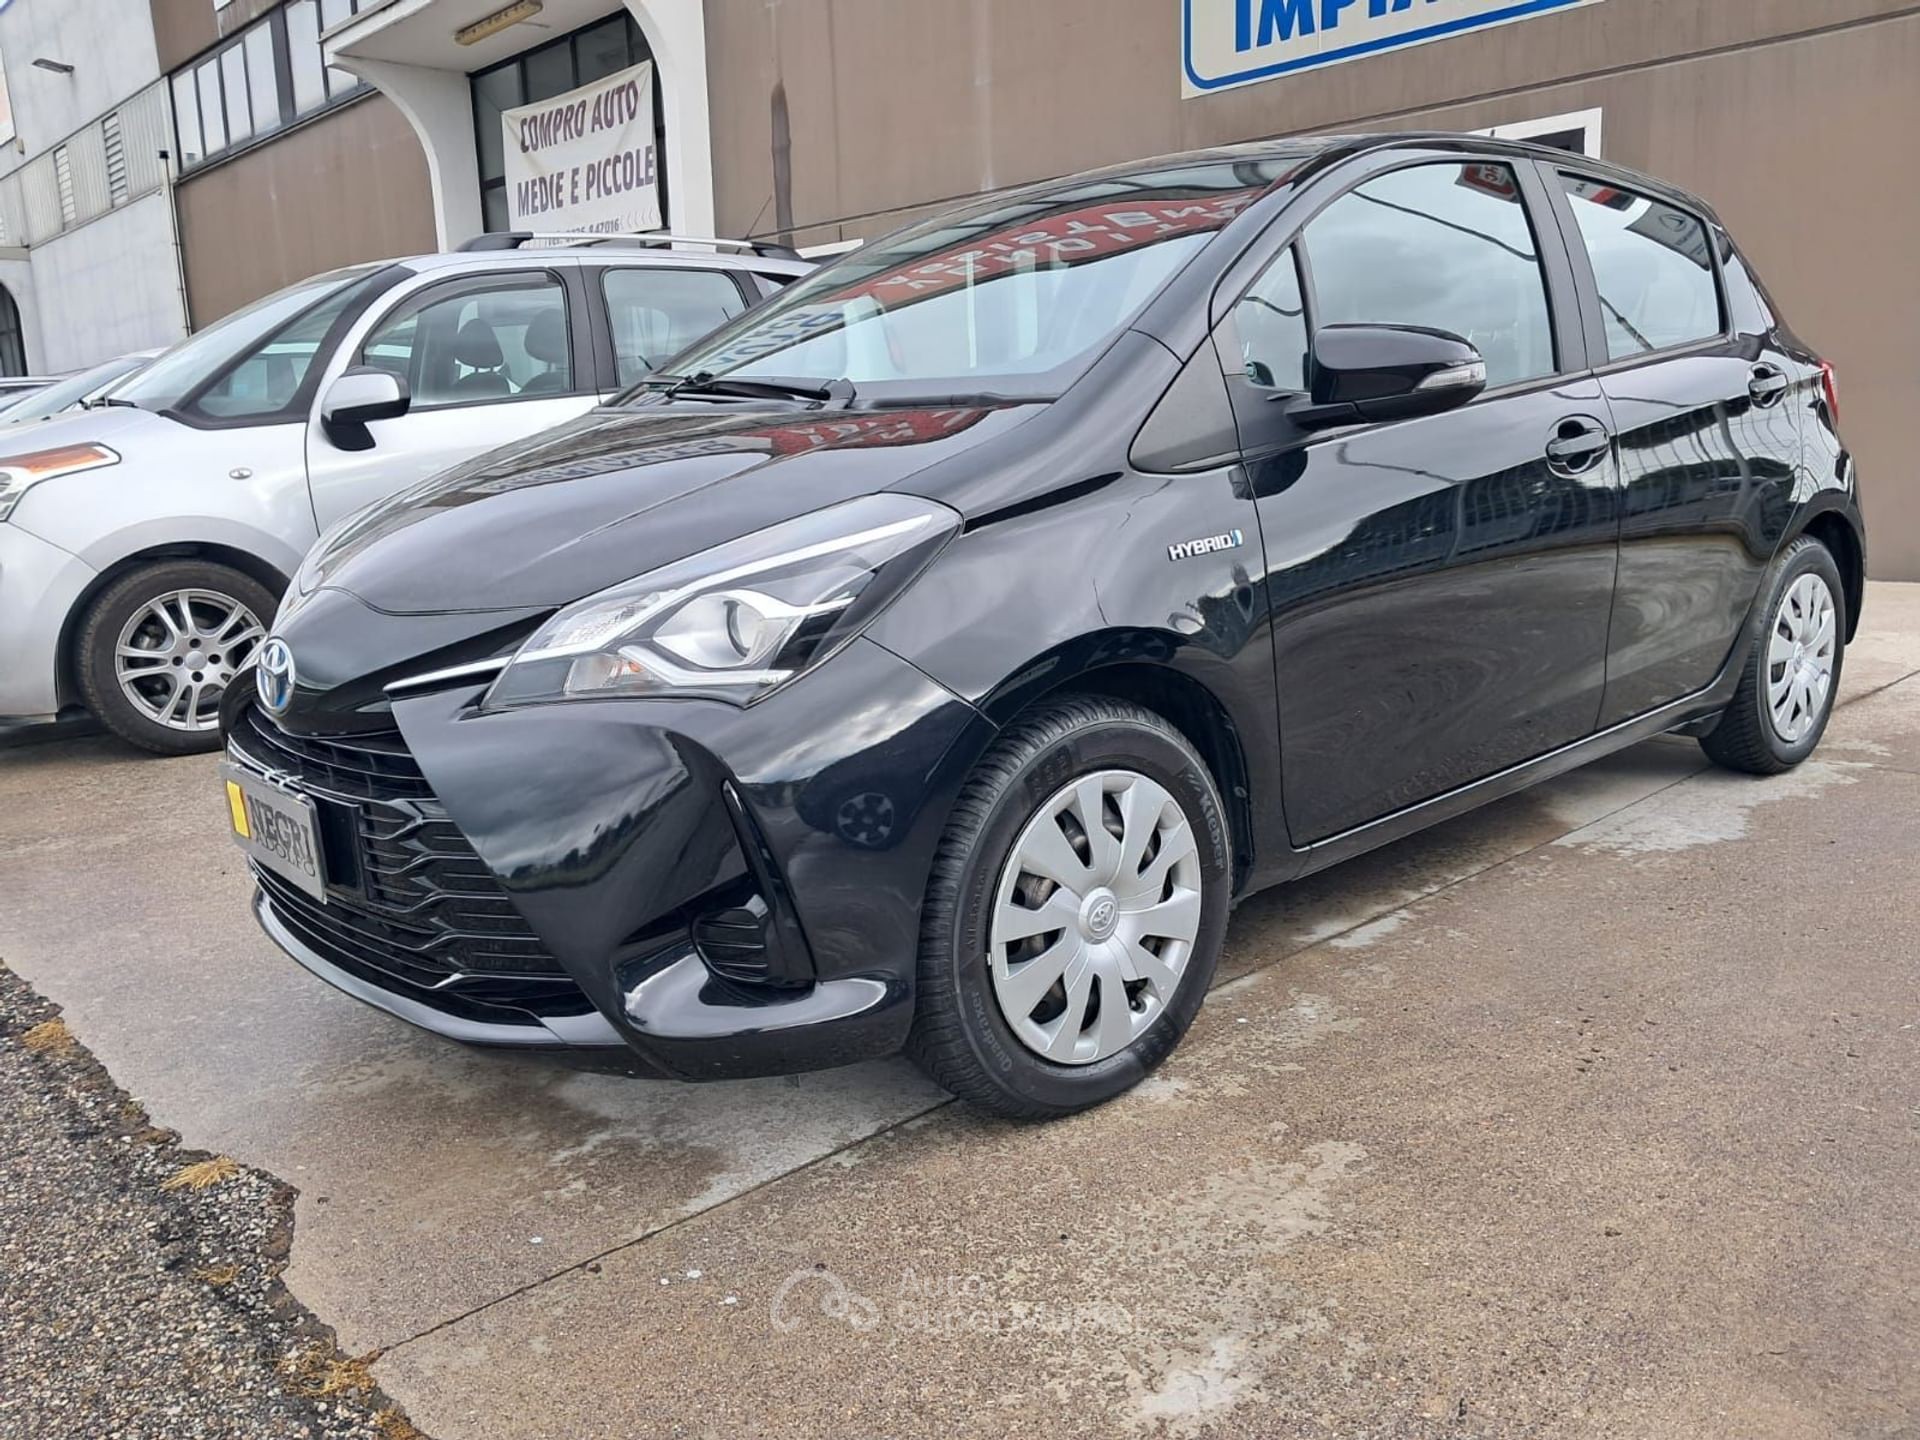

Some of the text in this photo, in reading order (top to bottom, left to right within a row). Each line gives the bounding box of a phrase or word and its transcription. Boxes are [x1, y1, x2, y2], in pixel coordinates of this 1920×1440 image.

[1235, 0, 1437, 52] IMP
[520, 80, 639, 153] COMPRO AUTO
[517, 145, 654, 217] MEDIE E PICCOLE
[1168, 533, 1232, 561] HYBRID
